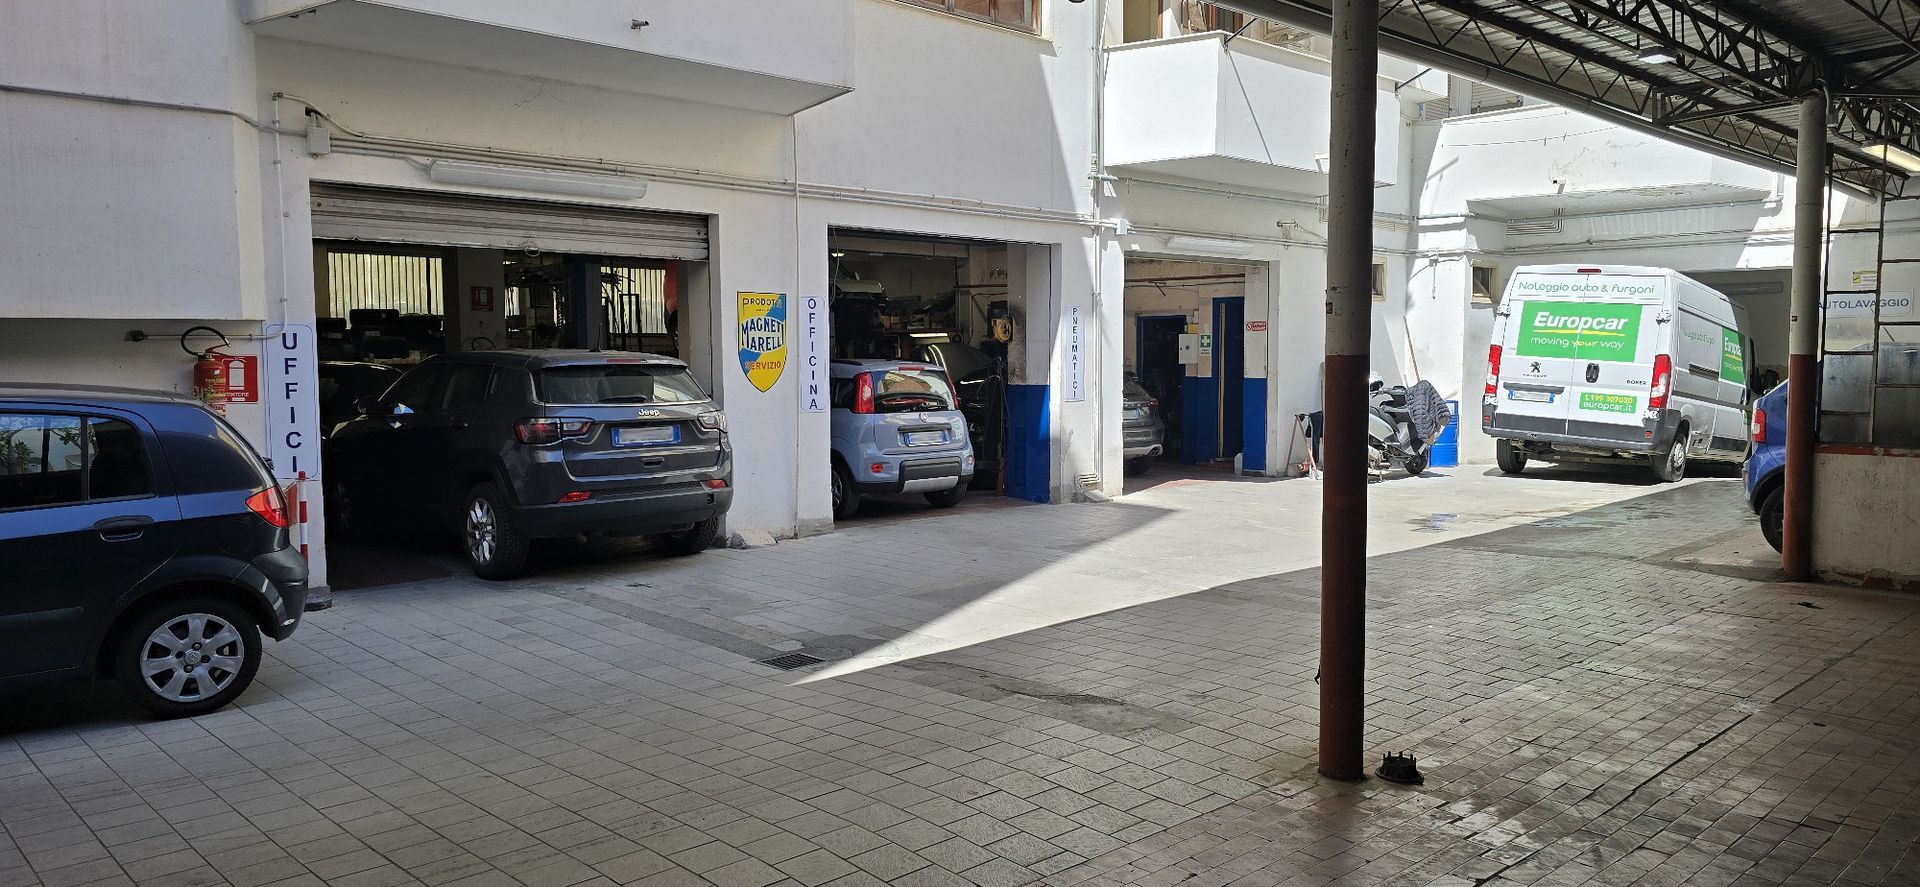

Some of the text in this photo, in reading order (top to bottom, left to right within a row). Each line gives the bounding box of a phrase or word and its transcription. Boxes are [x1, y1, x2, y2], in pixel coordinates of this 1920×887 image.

[1518, 281, 1655, 296] Noleggio auto & furgoni
[1533, 311, 1629, 333] Europcar
[1530, 337, 1625, 350] moving your way
[807, 298, 818, 410] OFFICINA
[745, 361, 782, 371] SERVIZIO
[282, 332, 302, 473] UFFICI
[1591, 394, 1633, 403] 199 307030
[638, 408, 660, 417] Jeep
[1583, 402, 1632, 411] europcar.it
